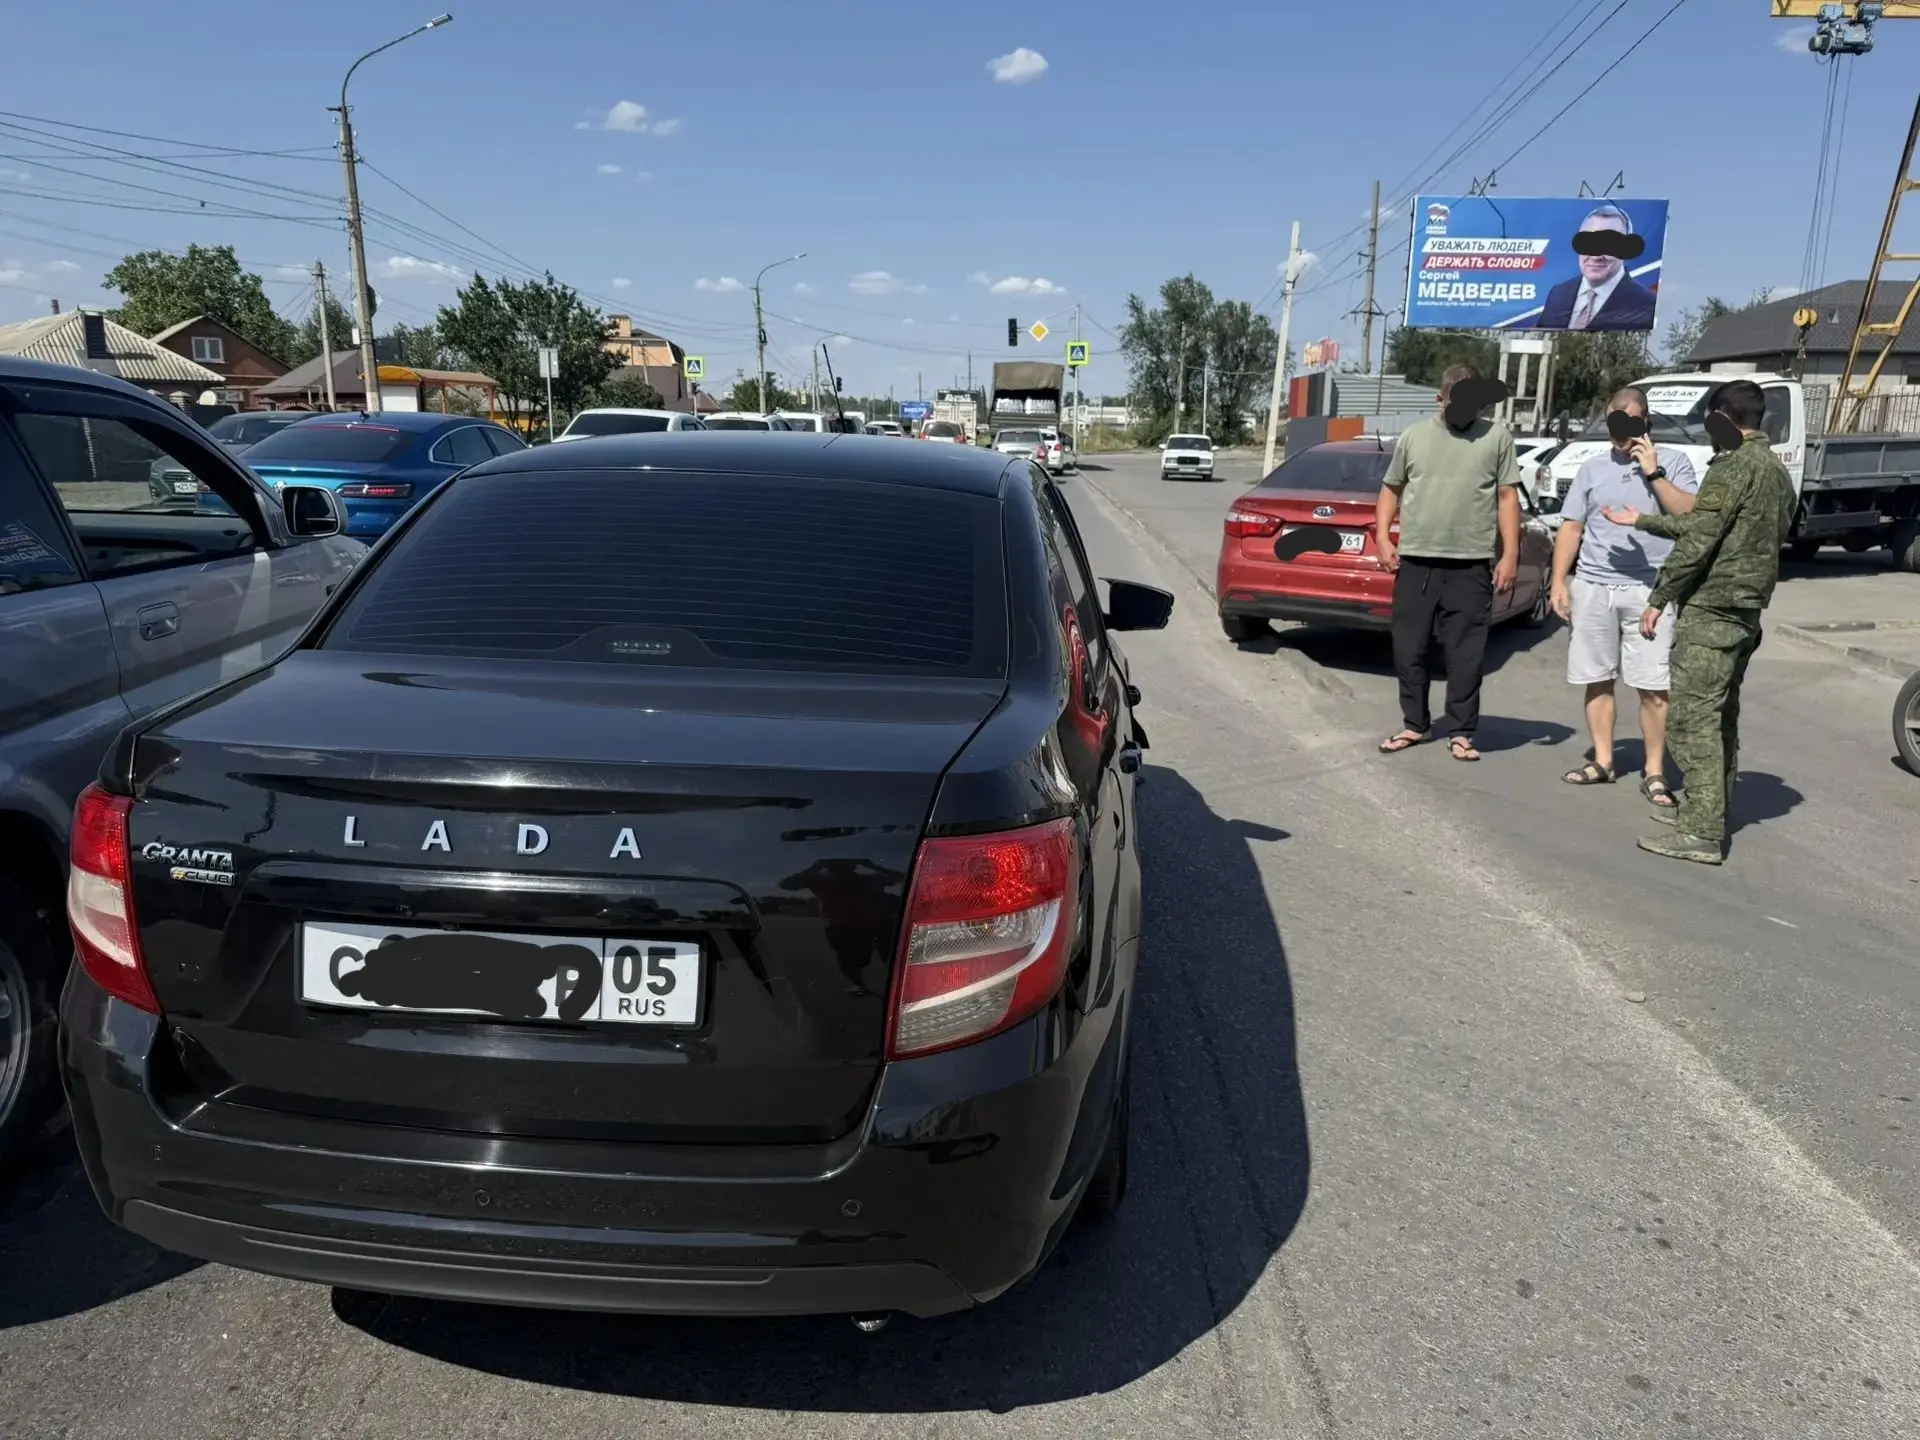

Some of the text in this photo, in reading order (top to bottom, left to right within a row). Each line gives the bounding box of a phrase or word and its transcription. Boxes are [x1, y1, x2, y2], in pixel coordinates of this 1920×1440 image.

[1430, 239, 1535, 253] УВАЖАТЬ ЛЮДЕЙ,
[1426, 257, 1536, 268] ДЕРЖАТЬ СЛОВО!
[1418, 270, 1460, 281] Сергей
[1418, 282, 1537, 302] МЕДВЕДЕВ
[343, 815, 643, 859] LADA
[142, 842, 235, 871] GRANTA
[611, 945, 677, 996] 05
[618, 997, 666, 1017] RUS
